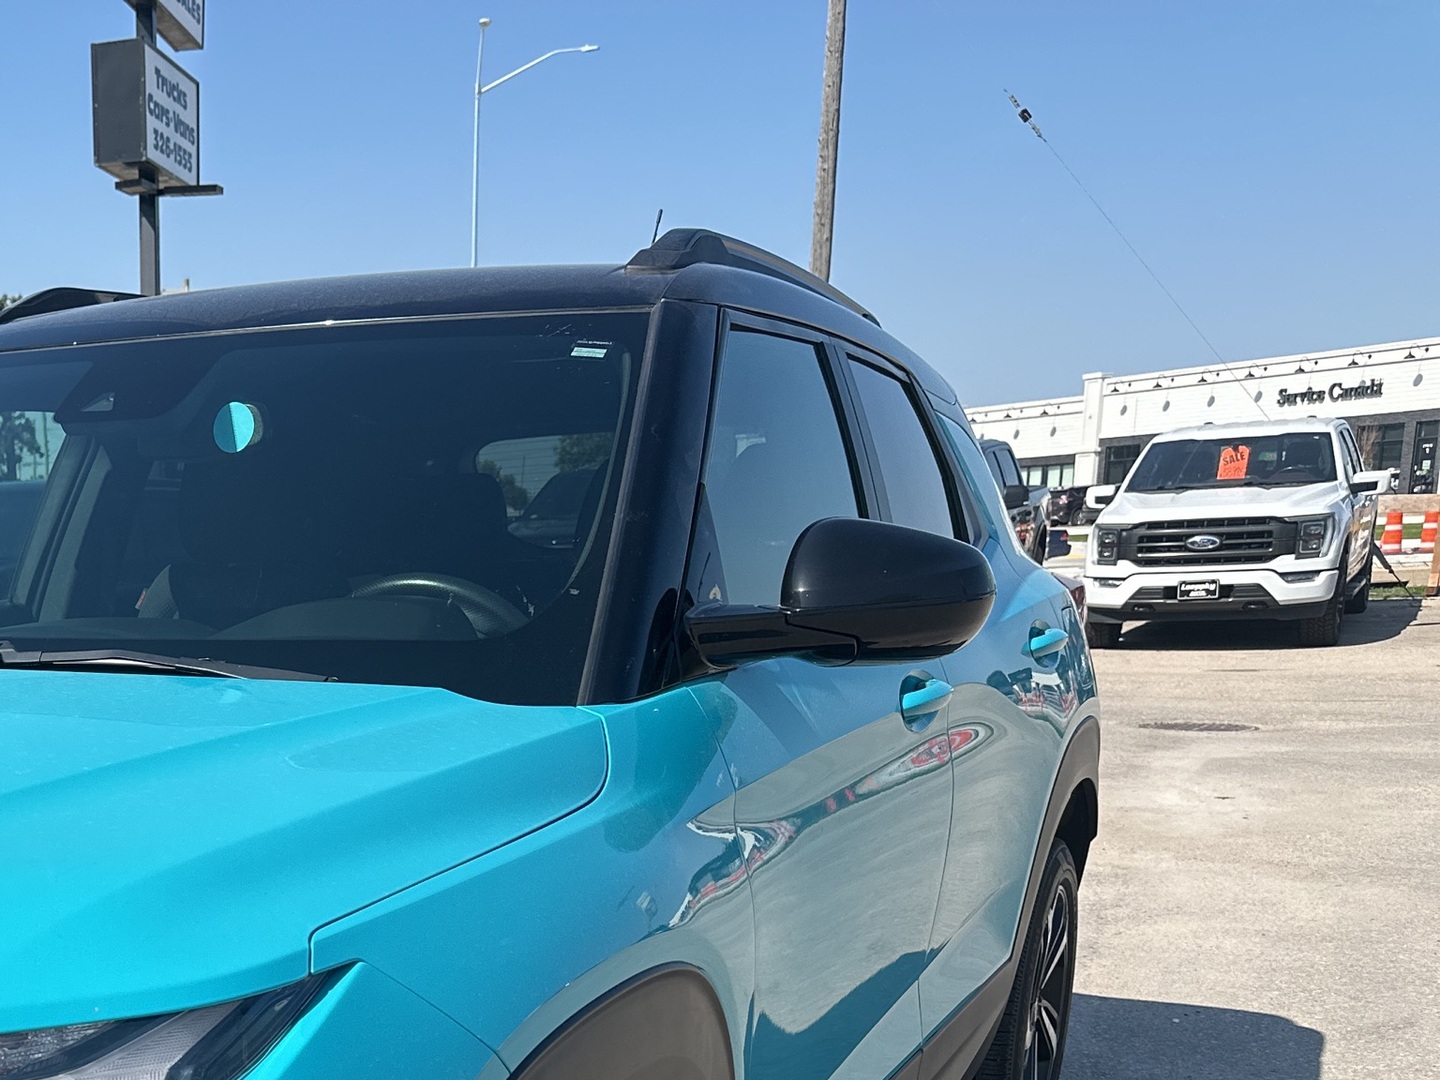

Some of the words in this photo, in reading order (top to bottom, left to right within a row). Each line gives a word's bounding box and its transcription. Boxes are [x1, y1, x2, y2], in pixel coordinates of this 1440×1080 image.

[176, 0, 201, 25] LES
[155, 66, 187, 111] Trucks
[1277, 387, 1326, 406] Service
[1328, 378, 1383, 402] Canada
[1222, 452, 1246, 466] SALE
